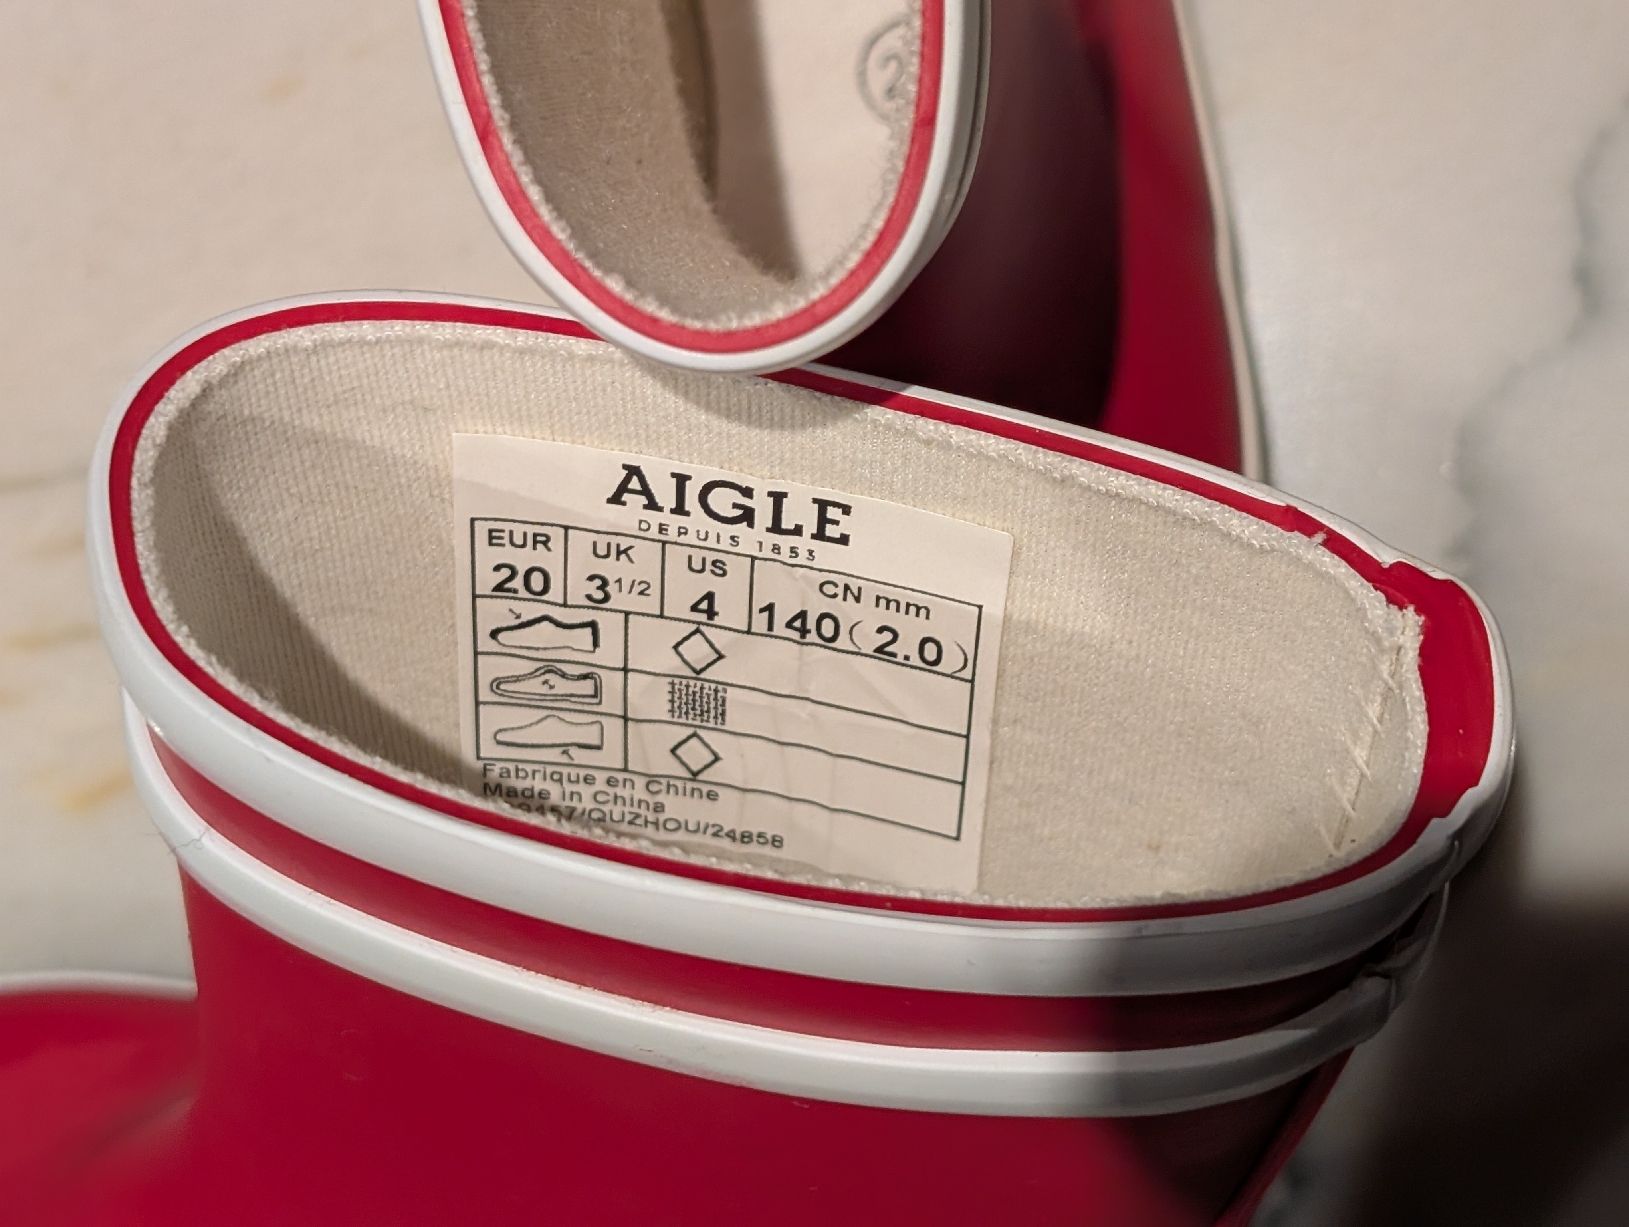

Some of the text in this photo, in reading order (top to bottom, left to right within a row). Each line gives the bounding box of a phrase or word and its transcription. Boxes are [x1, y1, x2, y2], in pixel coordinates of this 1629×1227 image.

[606, 463, 852, 546] AIGLE
[487, 528, 552, 552] EUR
[592, 540, 635, 564] UK
[638, 519, 816, 561] DEPUIS 1853
[491, 563, 551, 597] 20
[687, 554, 728, 578] US
[690, 591, 719, 621] 4
[818, 579, 931, 620] CN mm
[482, 762, 720, 801] Fabrique en Chine
[482, 782, 666, 813] Made in China
